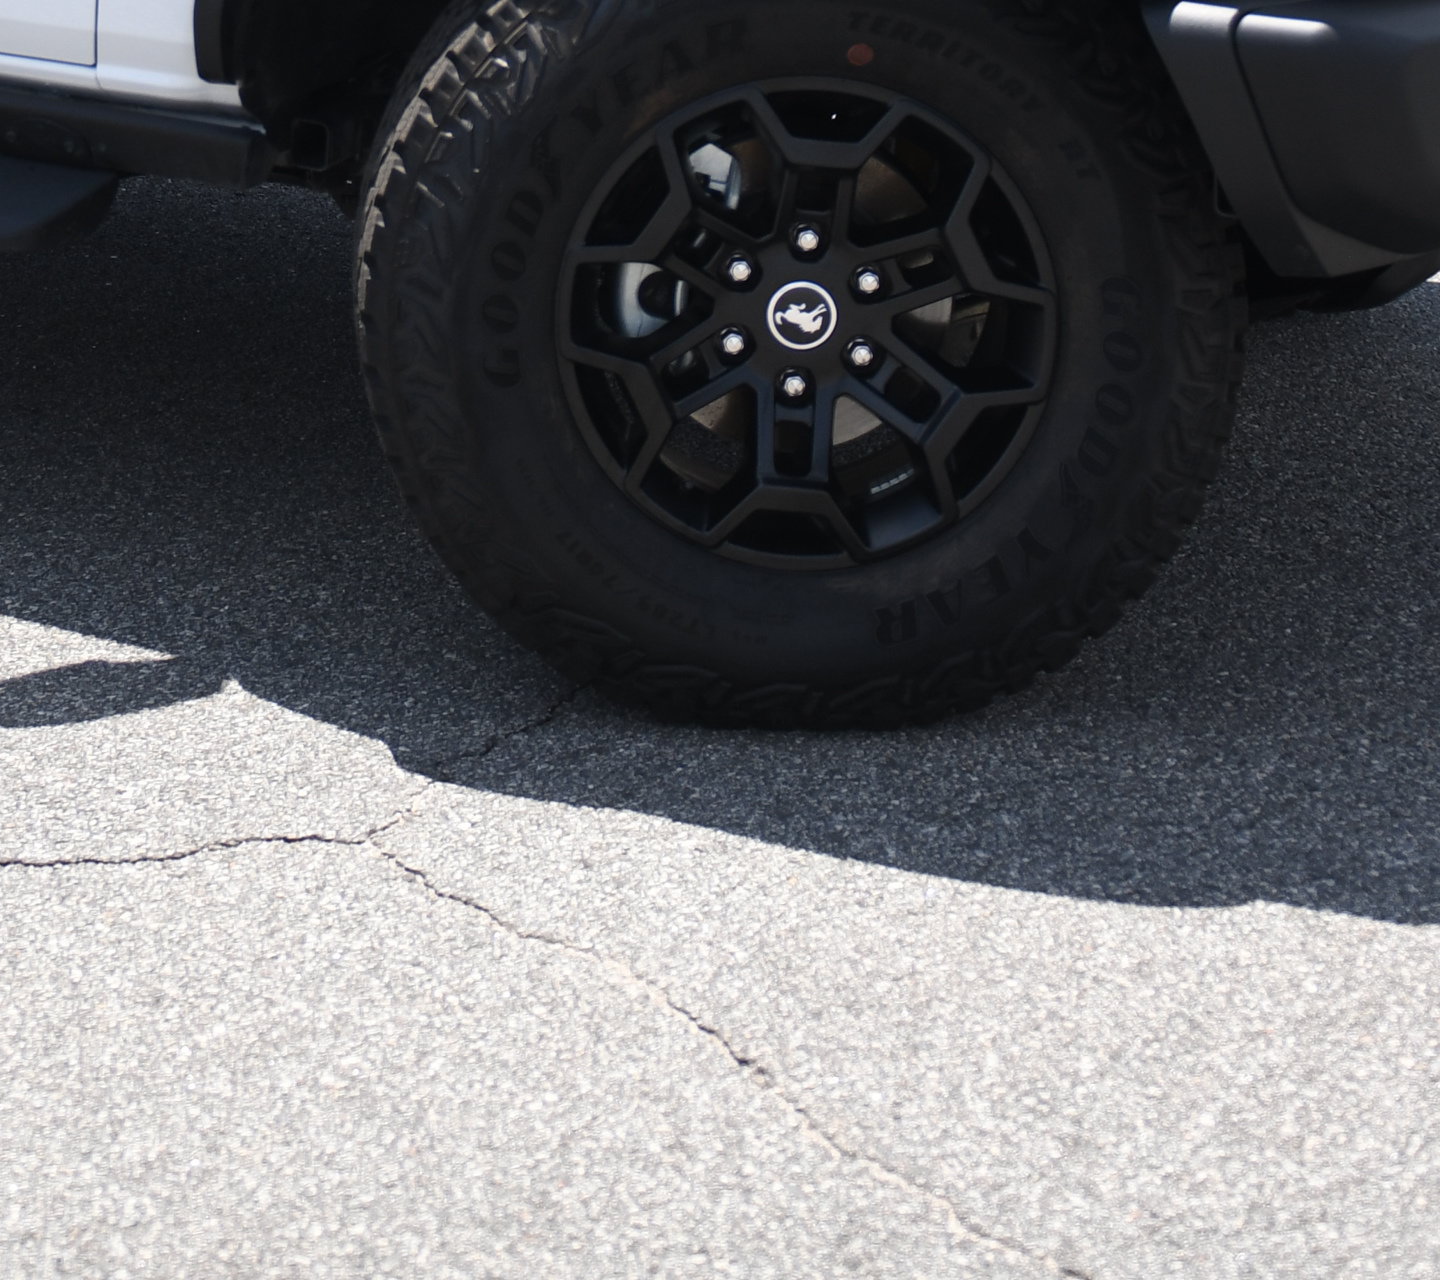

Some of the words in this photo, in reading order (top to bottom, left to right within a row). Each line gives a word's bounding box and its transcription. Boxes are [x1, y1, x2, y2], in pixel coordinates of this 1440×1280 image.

[480, 16, 750, 389] GOODYEAR
[847, 10, 1047, 114] TERRITORY
[873, 275, 1145, 650] GOODYEAR
